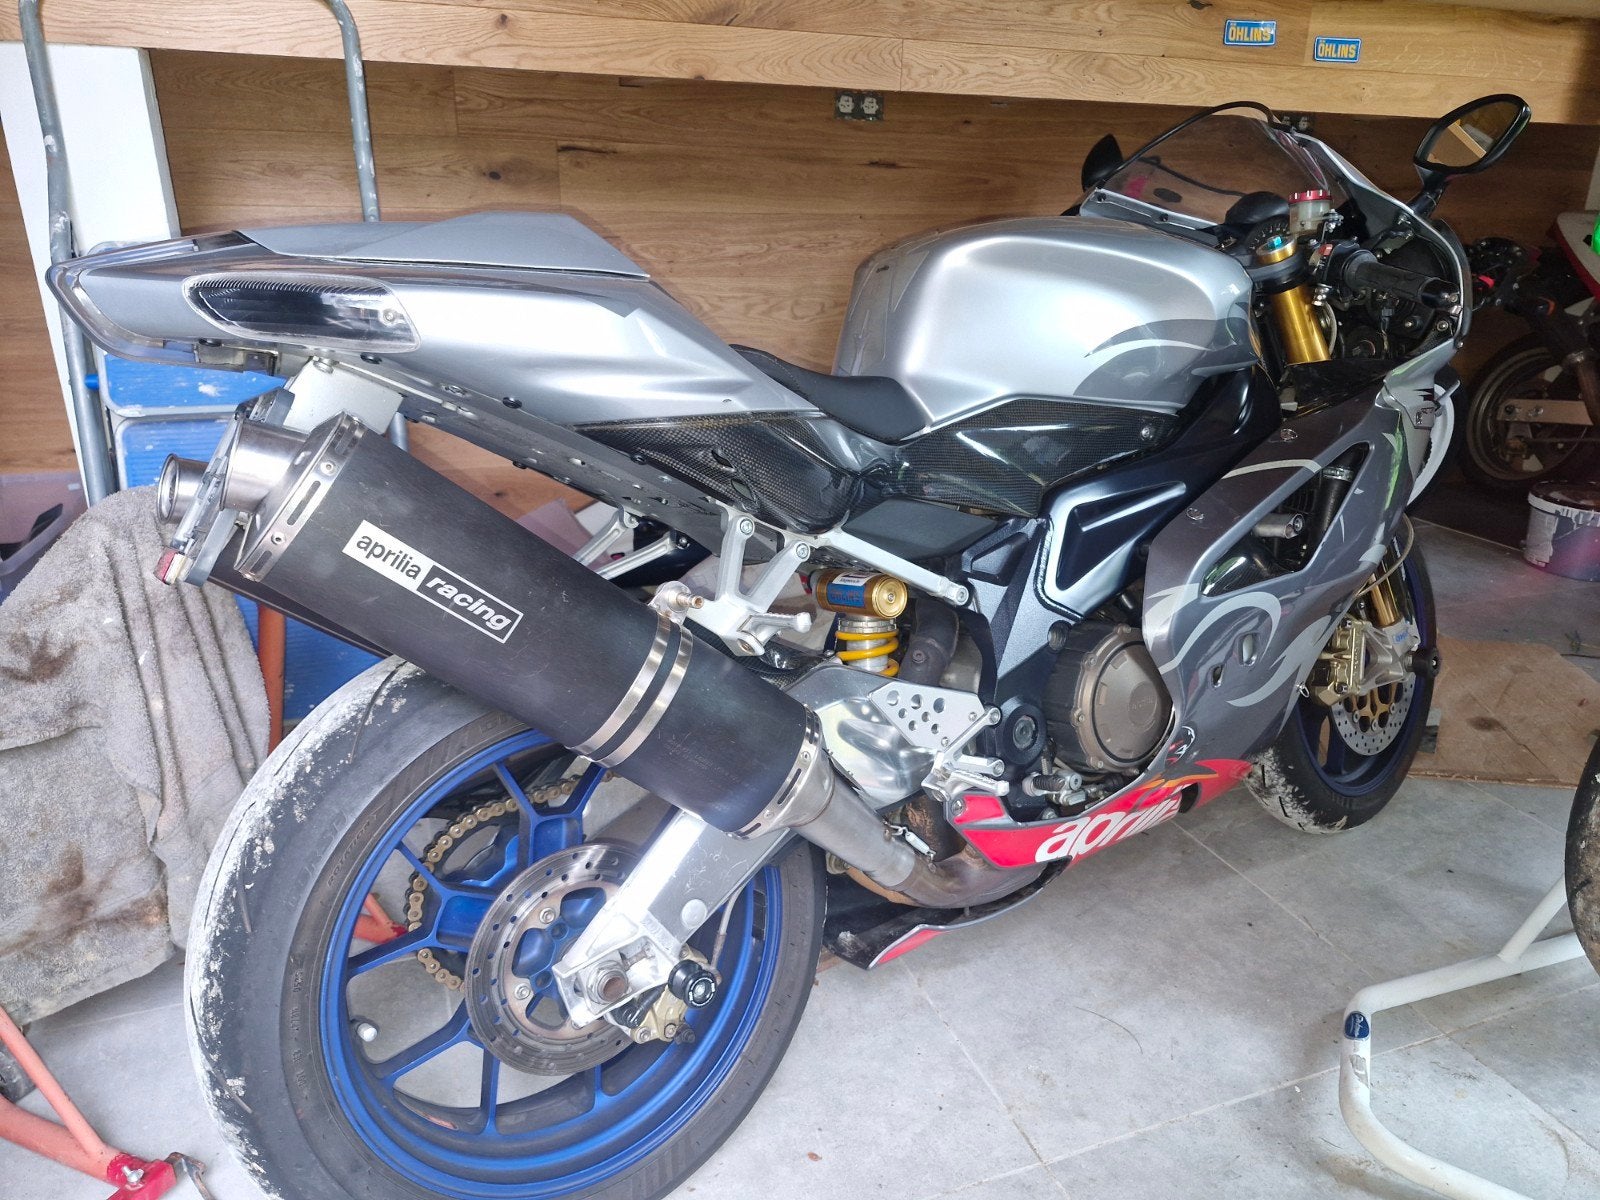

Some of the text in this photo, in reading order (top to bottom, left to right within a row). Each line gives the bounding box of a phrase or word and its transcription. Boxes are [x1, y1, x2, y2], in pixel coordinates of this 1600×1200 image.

[1229, 23, 1271, 42] ÖHLINS
[1318, 40, 1356, 58] ÖHLINS
[356, 535, 512, 631] aprilia racing
